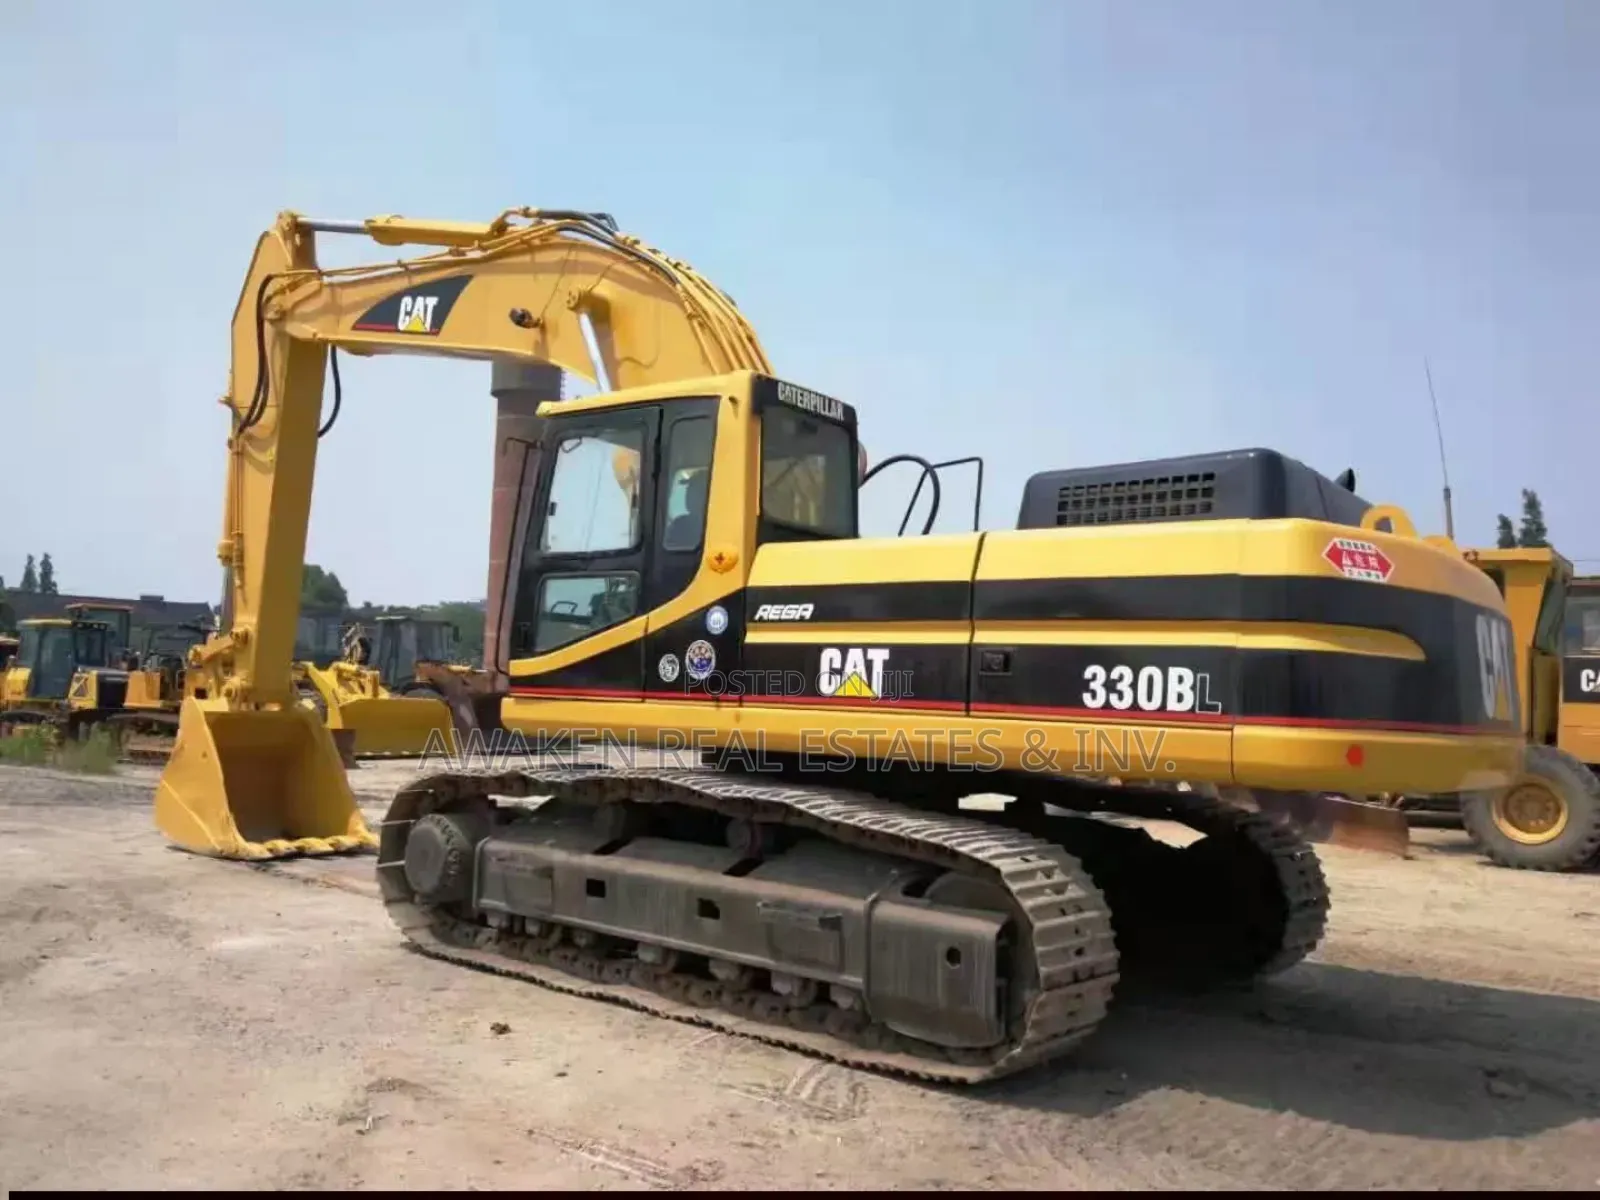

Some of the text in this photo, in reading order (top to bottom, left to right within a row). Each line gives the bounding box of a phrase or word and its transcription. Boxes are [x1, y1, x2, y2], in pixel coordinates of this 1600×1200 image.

[397, 296, 438, 332] CAT
[777, 381, 845, 421] CATERPILLAR
[819, 648, 890, 698] CAT
